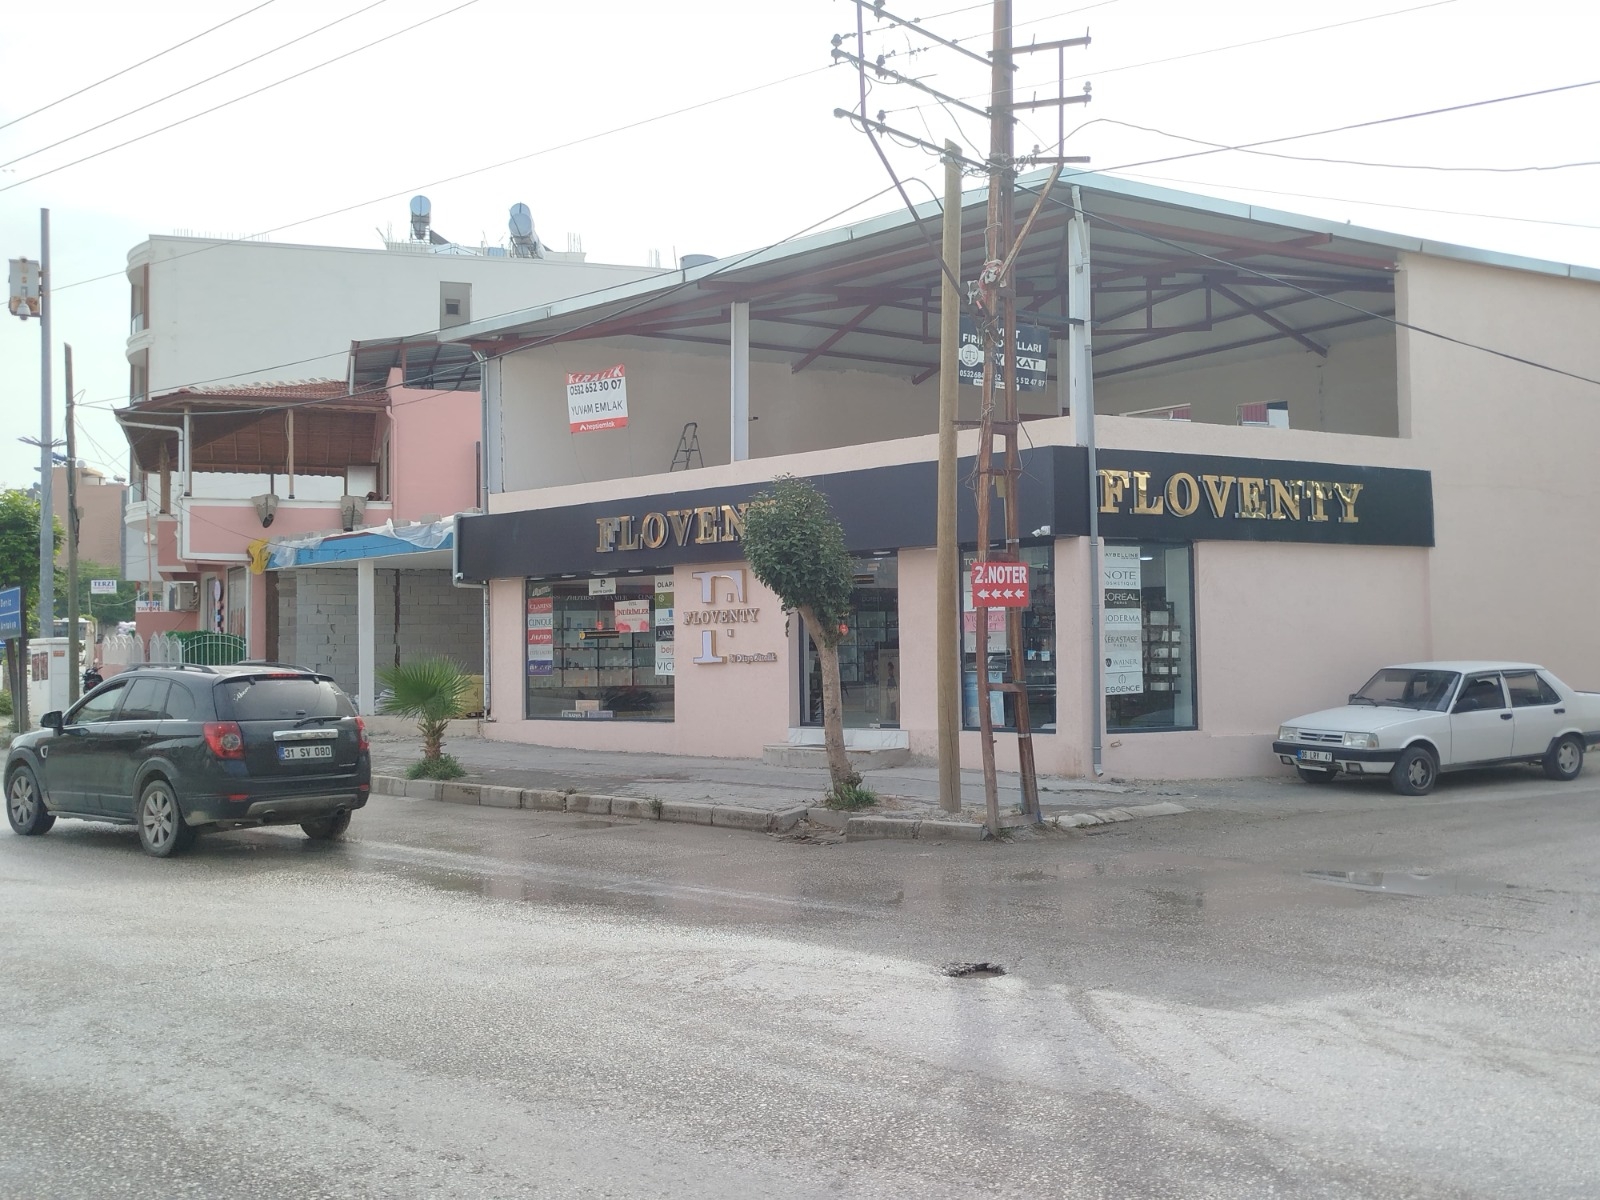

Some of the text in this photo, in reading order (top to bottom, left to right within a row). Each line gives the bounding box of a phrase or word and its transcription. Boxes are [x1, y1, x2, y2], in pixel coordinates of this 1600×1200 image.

[598, 380, 609, 391] 30
[611, 379, 622, 390] 07
[570, 400, 624, 416] YUVAM EMLAK
[1096, 469, 1364, 523] FLOVENTY
[596, 499, 768, 553] FLOVEN
[974, 565, 1028, 585] 2.NOTER
[683, 608, 760, 625] FLOVENTY
[1104, 614, 1140, 622] IODERMA
[285, 748, 295, 758] 31
[300, 747, 311, 757] SV
